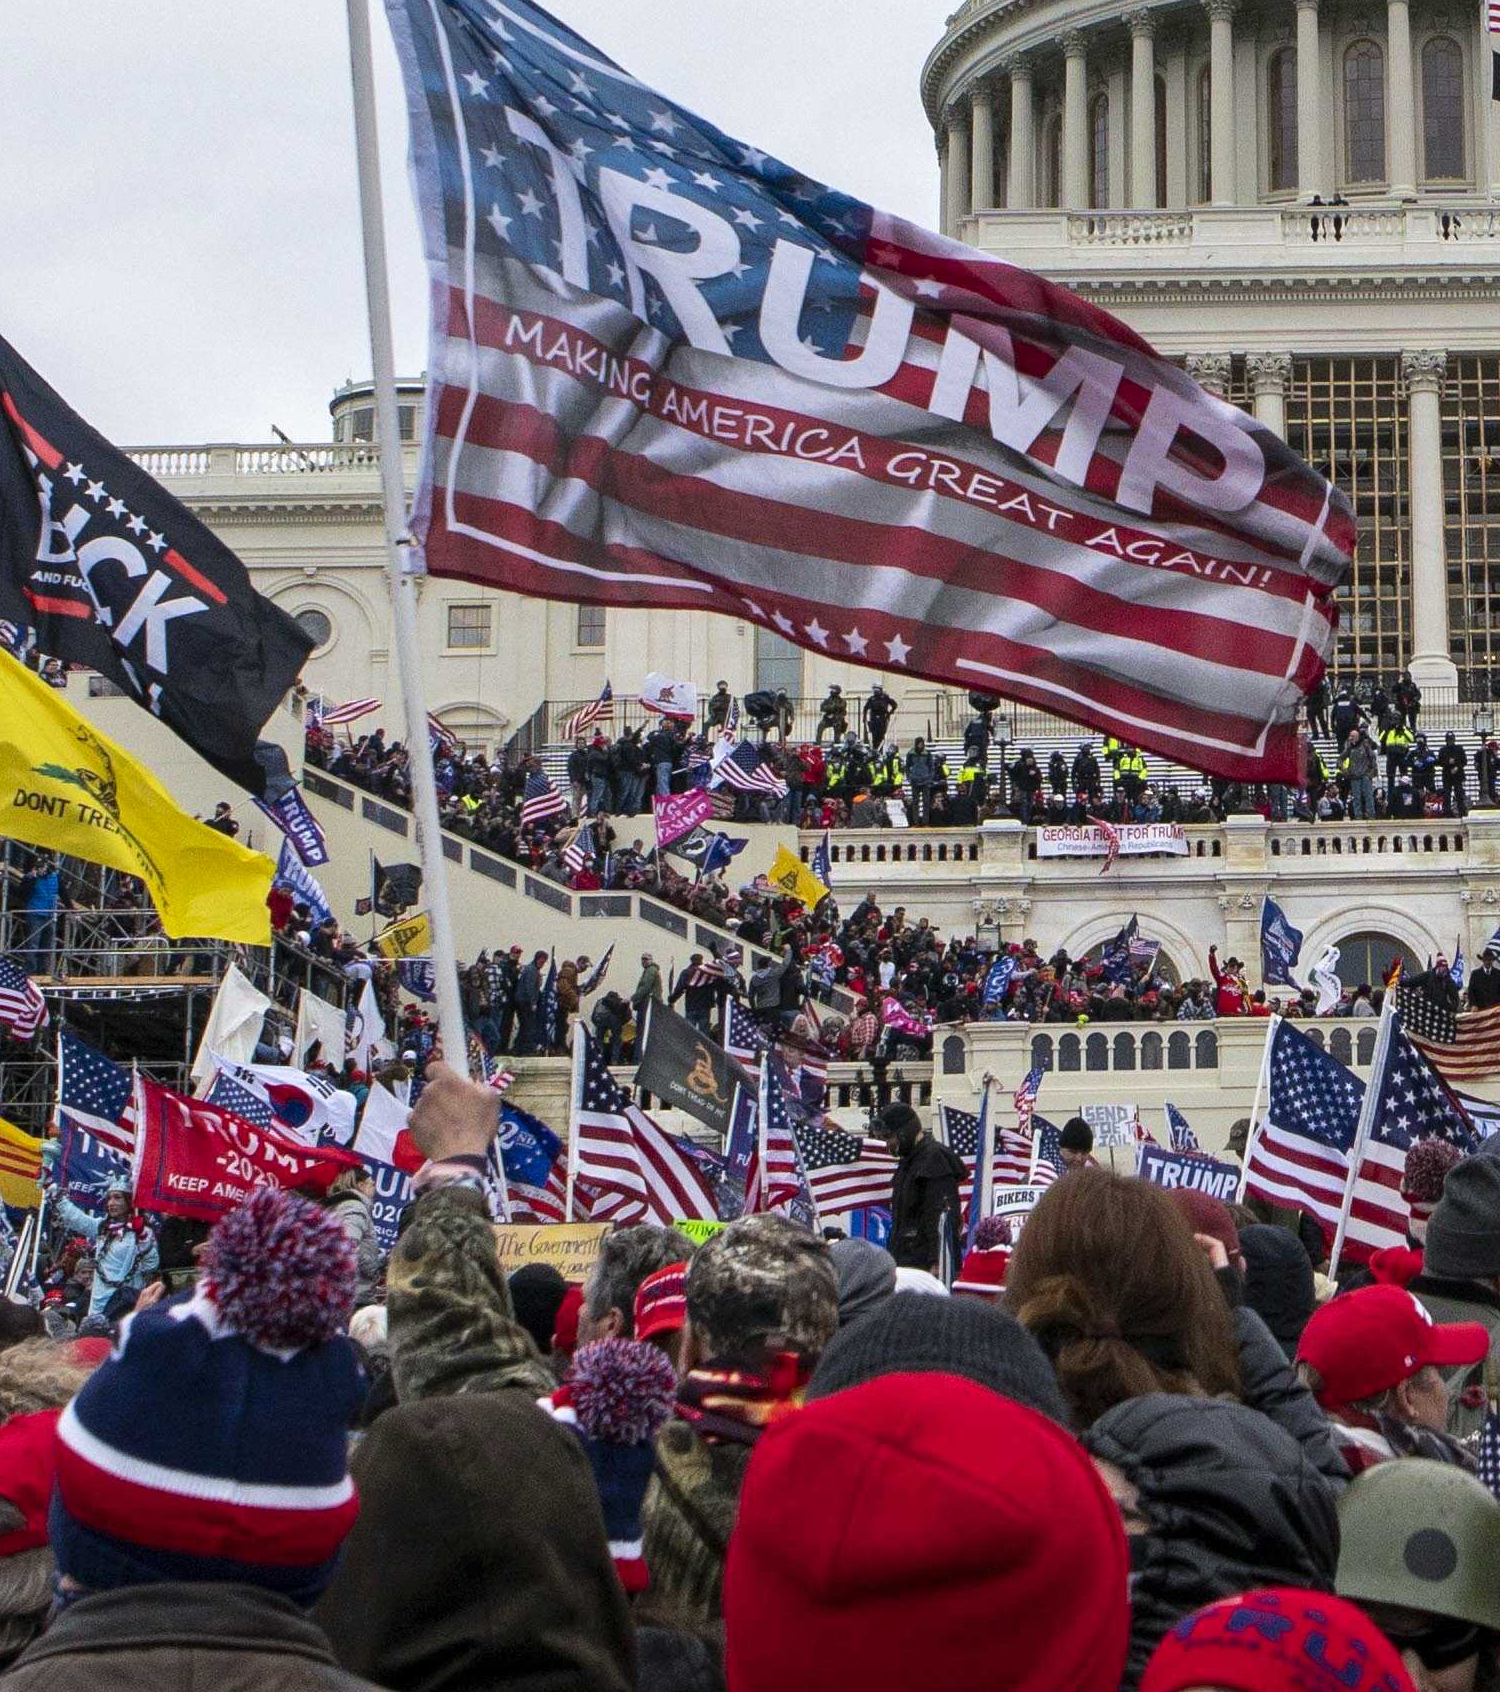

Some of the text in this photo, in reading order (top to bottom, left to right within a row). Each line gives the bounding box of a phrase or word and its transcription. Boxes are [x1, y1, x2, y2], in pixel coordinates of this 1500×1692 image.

[504, 107, 1267, 518] TRUMP
[506, 312, 1274, 588] MAKING AMERICA GREAT AGAIN!
[31, 572, 88, 592] AND FUC
[12, 788, 121, 833] DONT TRE
[280, 789, 324, 864] TRUMP
[1043, 827, 1091, 841] GEORGIA
[1127, 827, 1148, 840] FOR
[1085, 1106, 1130, 1123] SEND
[167, 1173, 209, 1191] KEEP
[1146, 1156, 1240, 1201] TRUMP
[996, 1191, 1035, 1208] BIKERS
[498, 1232, 528, 1258] The
